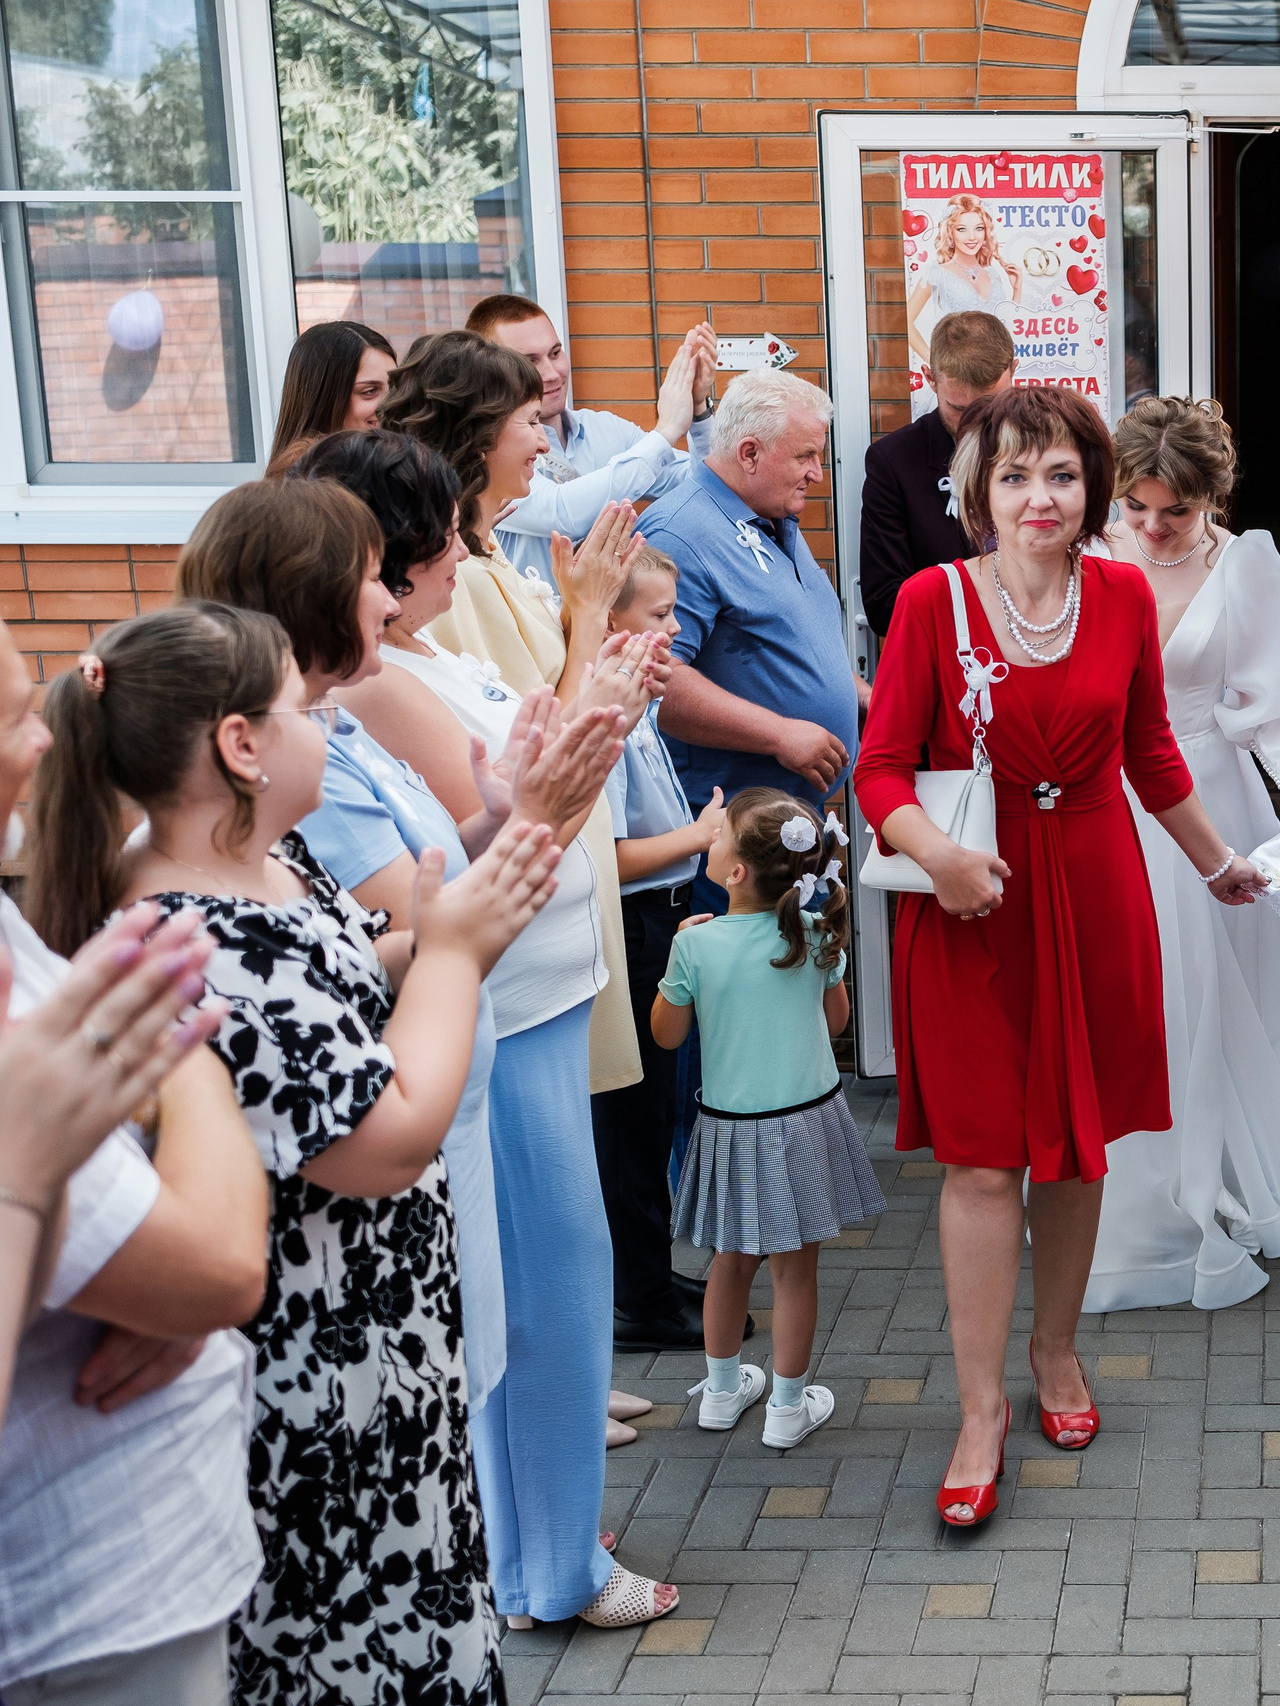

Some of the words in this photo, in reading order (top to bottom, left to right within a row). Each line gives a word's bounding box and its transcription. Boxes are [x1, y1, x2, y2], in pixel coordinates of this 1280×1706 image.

[910, 163, 1092, 188] ТИЛИ-ТИЛИ
[998, 205, 1086, 227] ТЕСТО
[1013, 317, 1079, 338] ЗДЕСЬ
[1014, 337, 1080, 357] живёт
[1014, 377, 1100, 395] ЕВЕСТА
